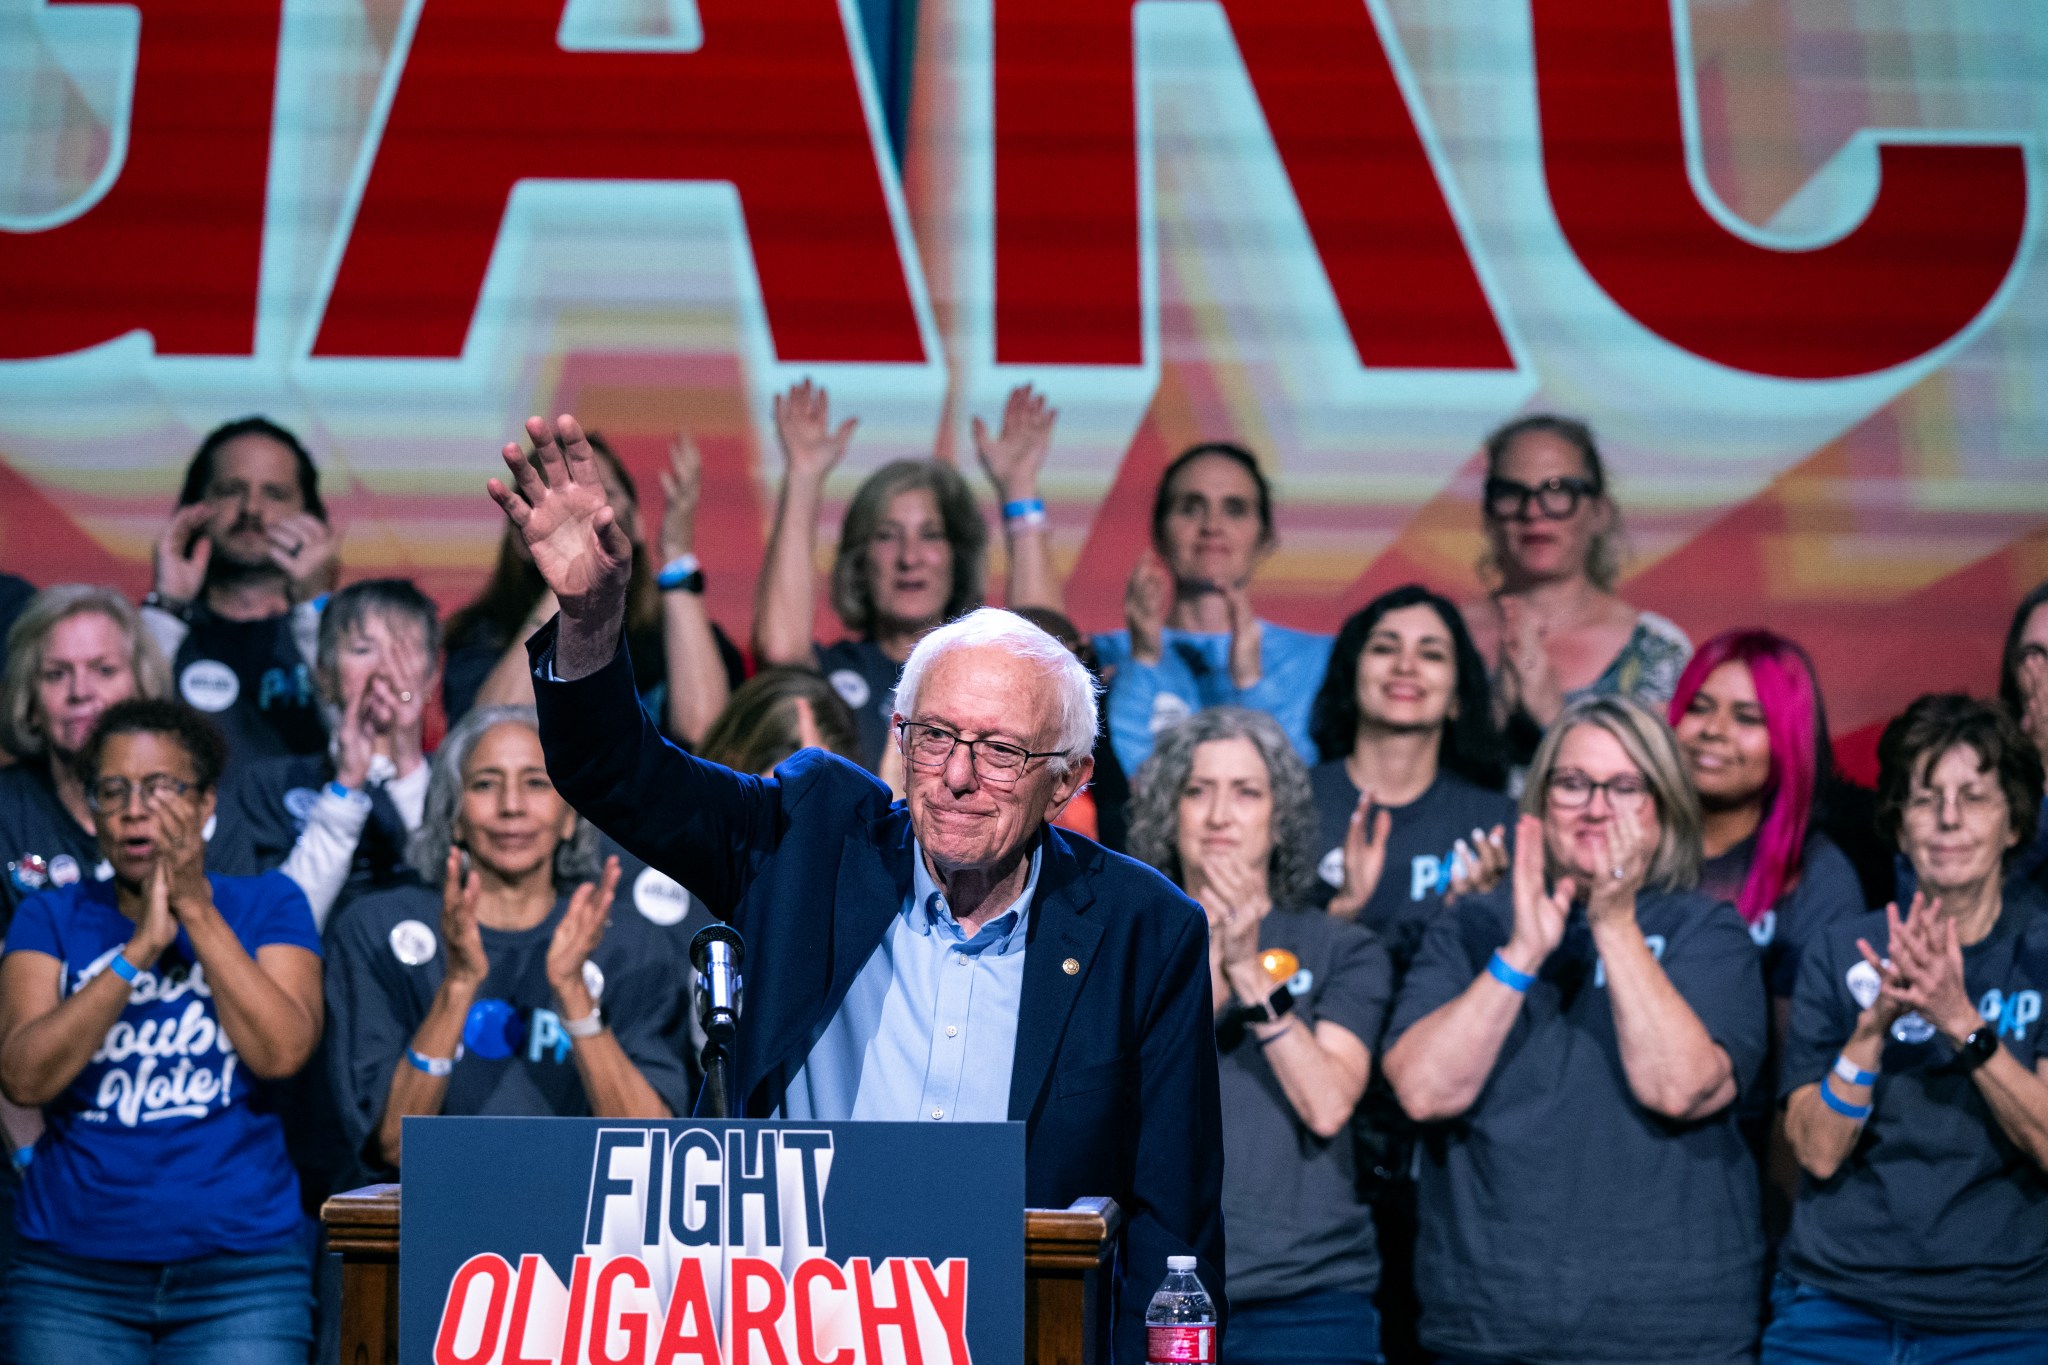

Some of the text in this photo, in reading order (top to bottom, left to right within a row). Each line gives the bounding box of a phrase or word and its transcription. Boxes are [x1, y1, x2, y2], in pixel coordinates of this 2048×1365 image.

[97, 1054, 238, 1128] Vote!
[583, 1128, 834, 1249] FIGHT
[432, 1252, 971, 1365] OLIGARCHY
